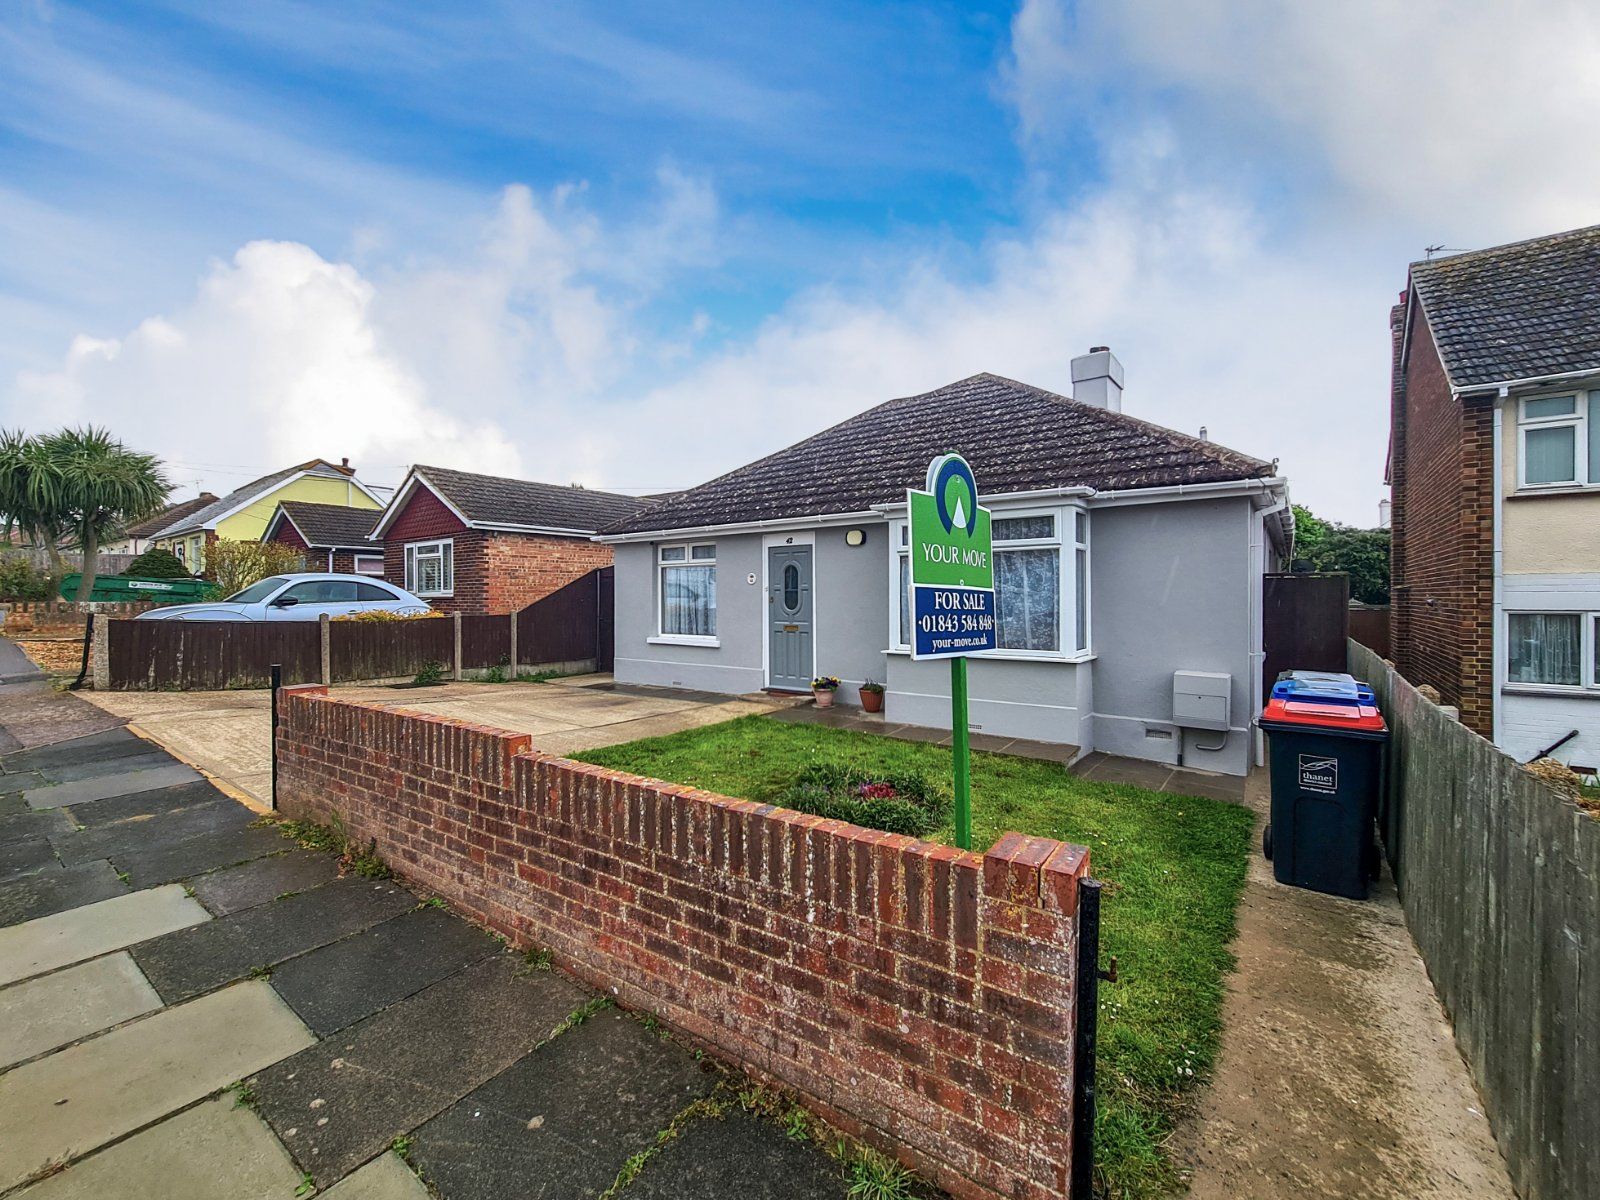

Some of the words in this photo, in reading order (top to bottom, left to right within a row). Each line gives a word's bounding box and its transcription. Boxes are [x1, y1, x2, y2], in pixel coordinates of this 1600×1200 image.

[922, 543, 960, 564] YOUR
[962, 548, 987, 568] MOVE
[934, 592, 961, 609] FOR
[963, 593, 985, 610] SALE
[922, 613, 958, 632] 01843
[961, 614, 978, 632] 584
[932, 633, 987, 652] your-move.co.uk
[1303, 772, 1334, 782] thanet
